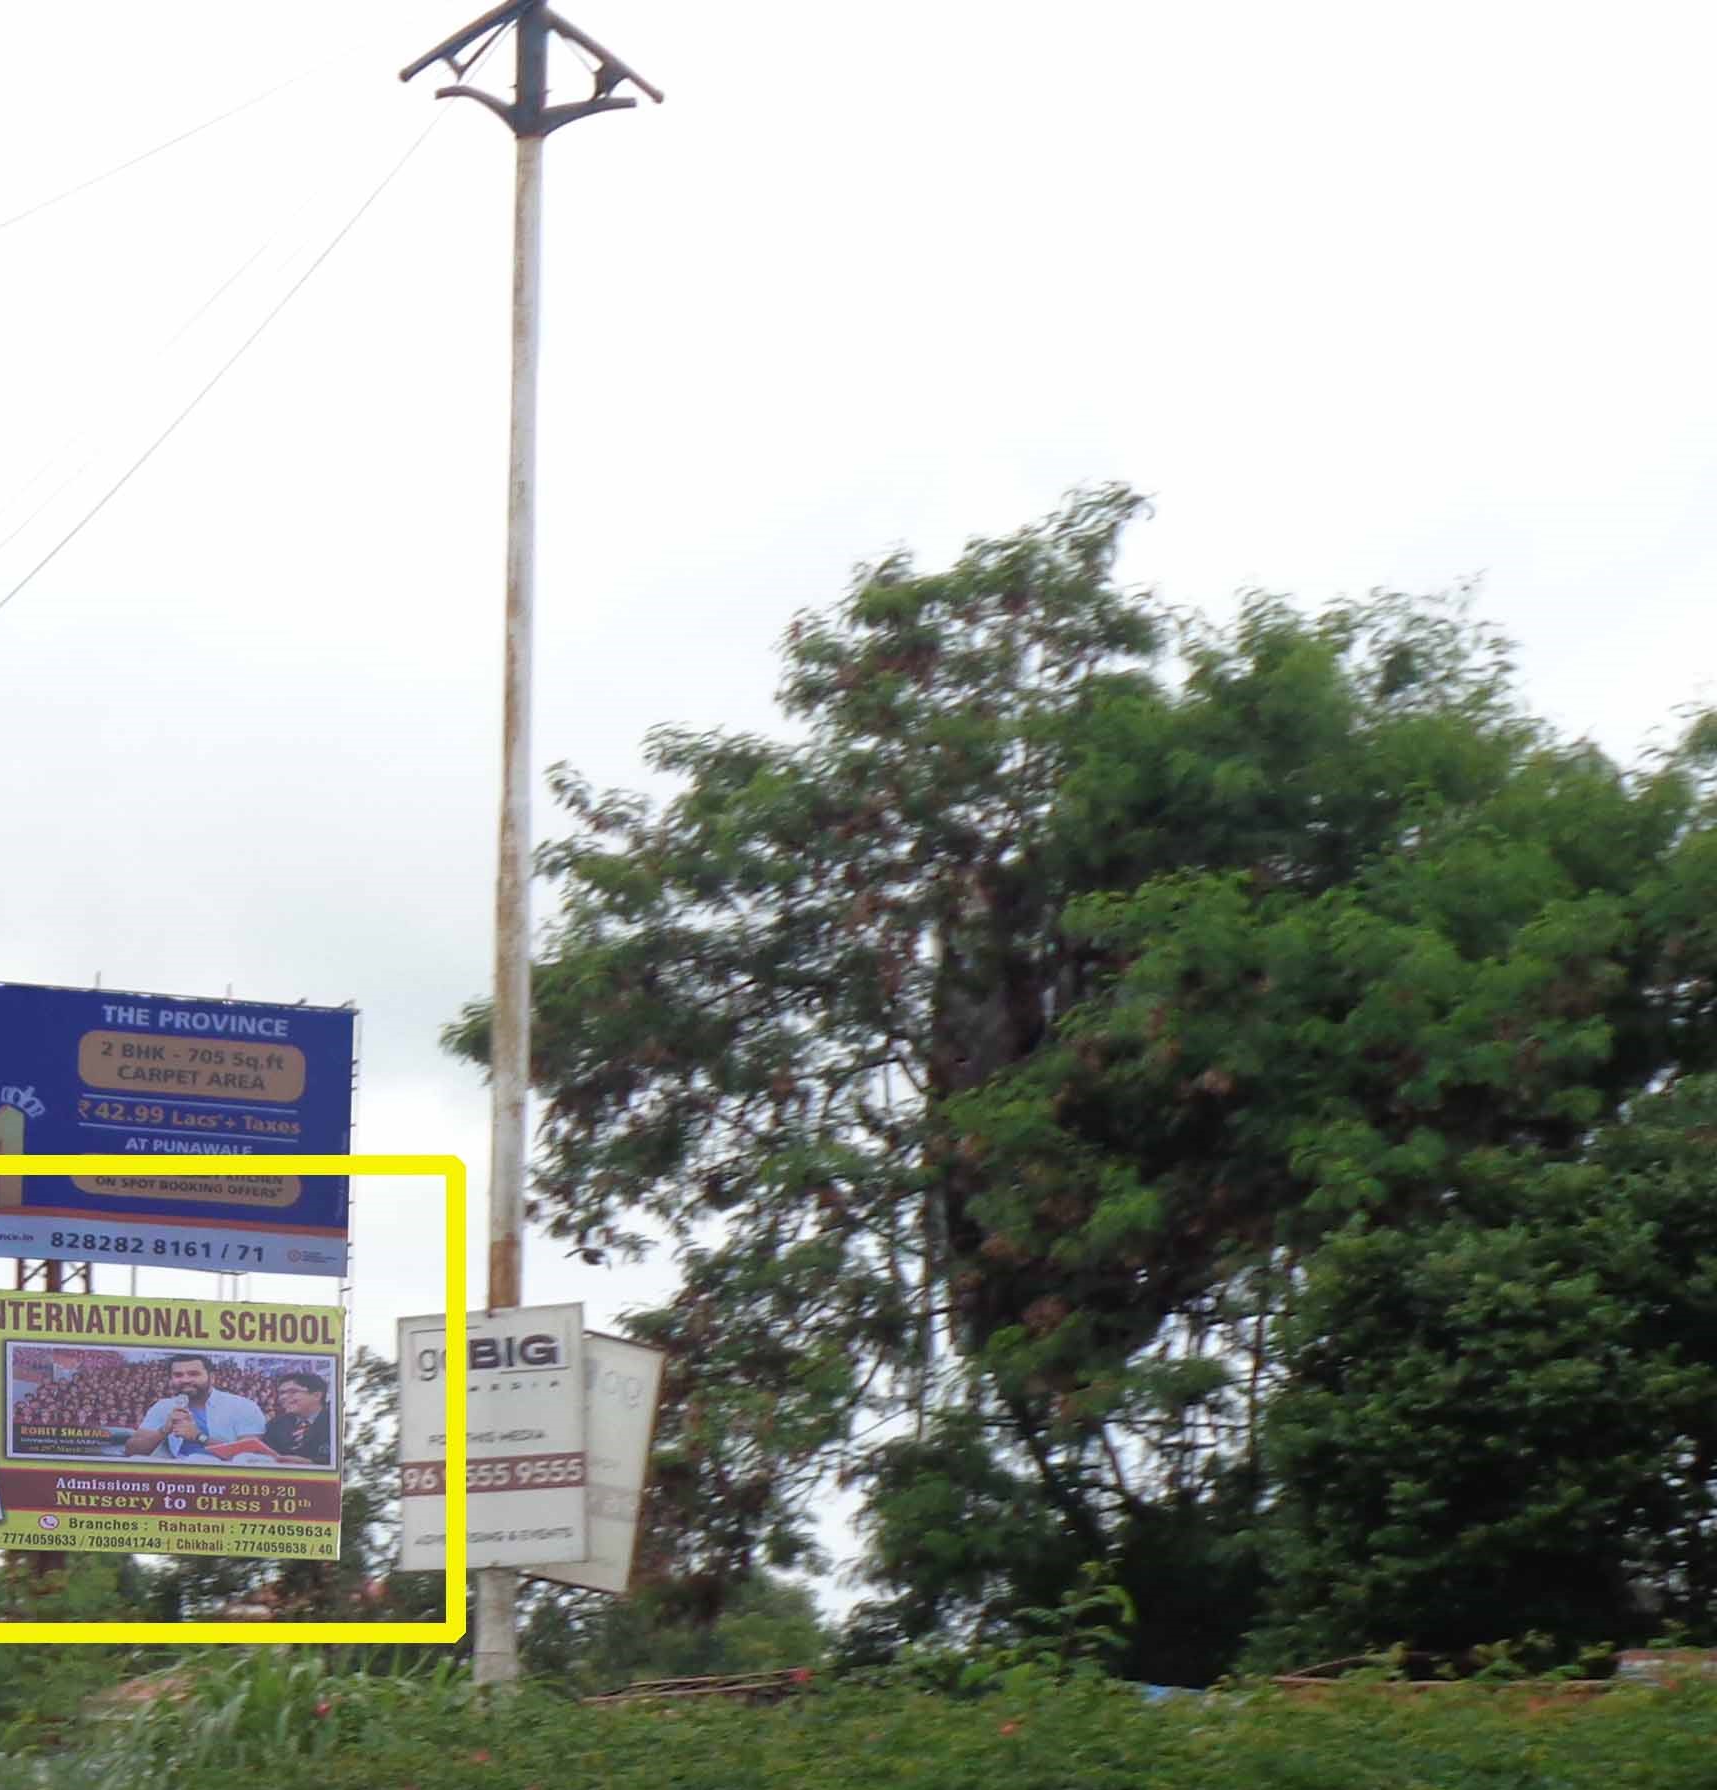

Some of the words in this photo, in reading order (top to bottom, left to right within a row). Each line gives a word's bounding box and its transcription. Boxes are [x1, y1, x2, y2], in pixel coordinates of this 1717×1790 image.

[102, 1005, 150, 1026] THE
[158, 1010, 289, 1037] PROVINCE
[101, 1041, 113, 1057] 2
[122, 1044, 165, 1061] BHK
[188, 1049, 225, 1066] 705
[117, 1065, 198, 1086] CARPET
[207, 1071, 265, 1090] AREA
[244, 1116, 301, 1133] Taxes
[125, 1138, 151, 1150] AT
[95, 1176, 115, 1187] ON
[121, 1178, 156, 1190] SPOT
[159, 1180, 223, 1194] BOOKING
[50, 1231, 143, 1254] 828282
[153, 1241, 212, 1259] 8161
[237, 1244, 264, 1262] 71
[219, 1310, 335, 1345] SCHOOL
[21, 1426, 57, 1436] ROHIT
[515, 1457, 584, 1483] 9555
[56, 1478, 150, 1493] Admissions
[157, 1481, 196, 1495] Open
[202, 1482, 226, 1495] for
[230, 1483, 296, 1498] 2019-20
[56, 1490, 155, 1511] Nursery
[165, 1496, 187, 1510] to
[196, 1497, 262, 1513] Class
[69, 1518, 139, 1531] Branches
[158, 1520, 225, 1534] Rahatani
[240, 1523, 333, 1538] 7774059634
[3, 1532, 77, 1546] 7774059633
